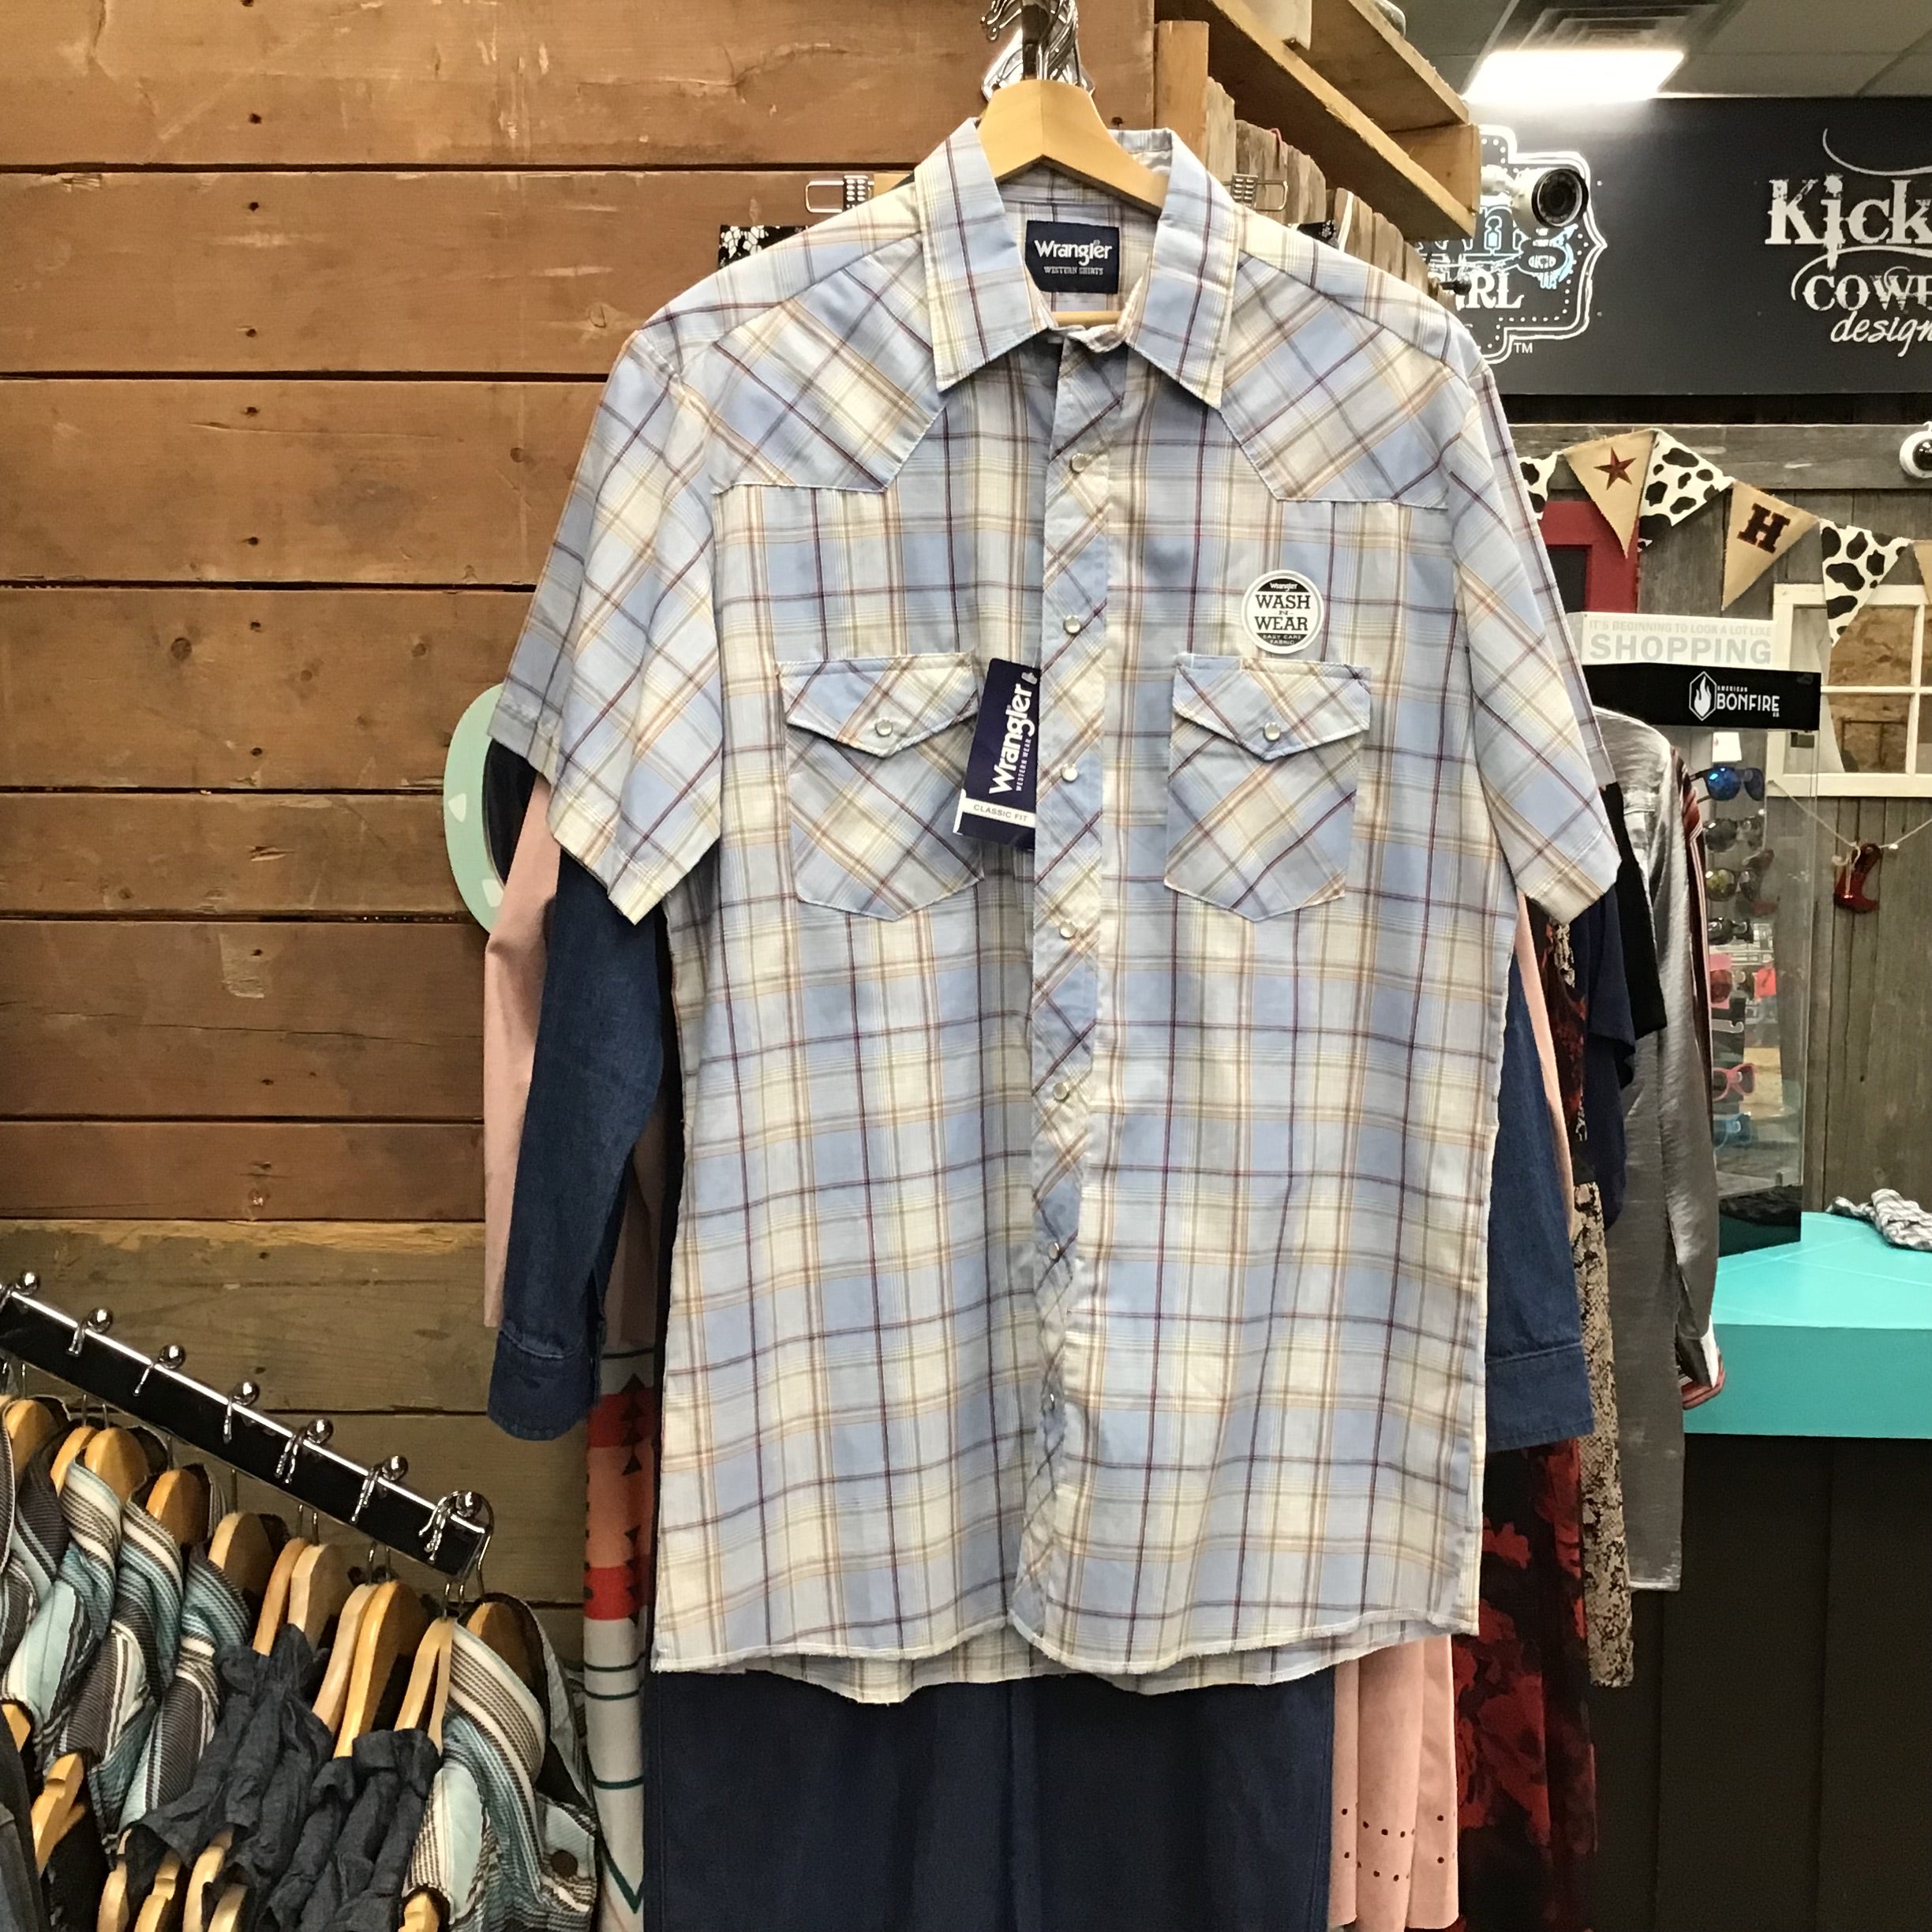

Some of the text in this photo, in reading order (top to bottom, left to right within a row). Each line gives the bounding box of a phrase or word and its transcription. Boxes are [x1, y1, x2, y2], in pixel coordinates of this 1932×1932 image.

[1034, 239, 1113, 266] Wrangler
[1043, 265, 1104, 275] WESTERN SHIRTS
[1514, 343, 1533, 354] TM
[1736, 502, 1791, 554] H
[1269, 582, 1298, 592] Wrangler
[1255, 594, 1311, 609] WASH
[1254, 616, 1309, 631] WEAR
[1612, 620, 1672, 633] BEGINNING
[1675, 623, 1689, 634] TO
[1690, 624, 1719, 635] LOOK
[1720, 626, 1728, 635] A
[1729, 627, 1749, 636] LOT
[1750, 627, 1772, 637] LIKE
[1589, 633, 1772, 665] SHOPPING
[1717, 692, 1780, 712] BONFIRE
[988, 683, 1036, 795] Wrangler
[973, 803, 1029, 822] CLASSIC FIT
